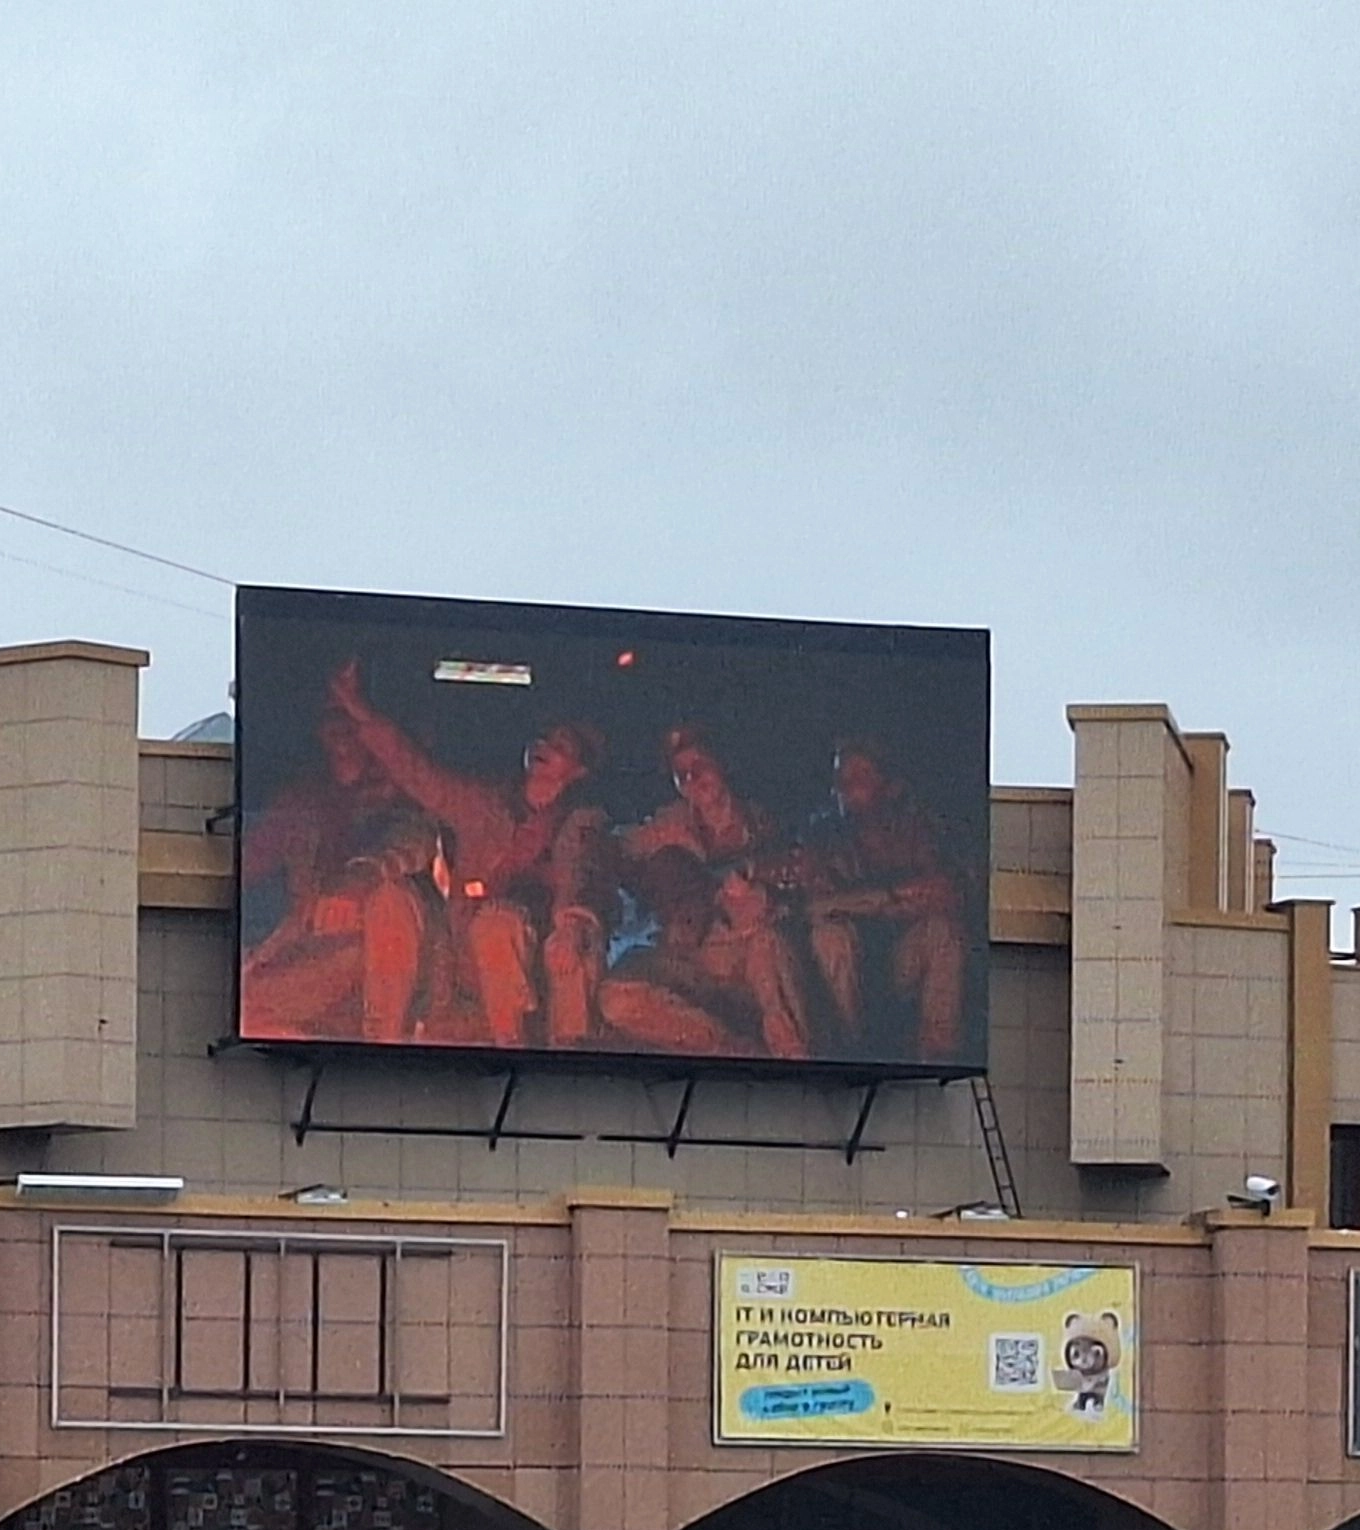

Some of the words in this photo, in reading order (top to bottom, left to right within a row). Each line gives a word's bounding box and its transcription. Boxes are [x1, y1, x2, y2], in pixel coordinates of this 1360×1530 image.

[781, 1308, 950, 1328] КОМПЬЮТЕРНАЯ
[736, 1330, 883, 1350] ГРАМОТНОСТЬ
[735, 1352, 778, 1370] ДЛЯ
[786, 1352, 852, 1372] ДЕТЕЙ
